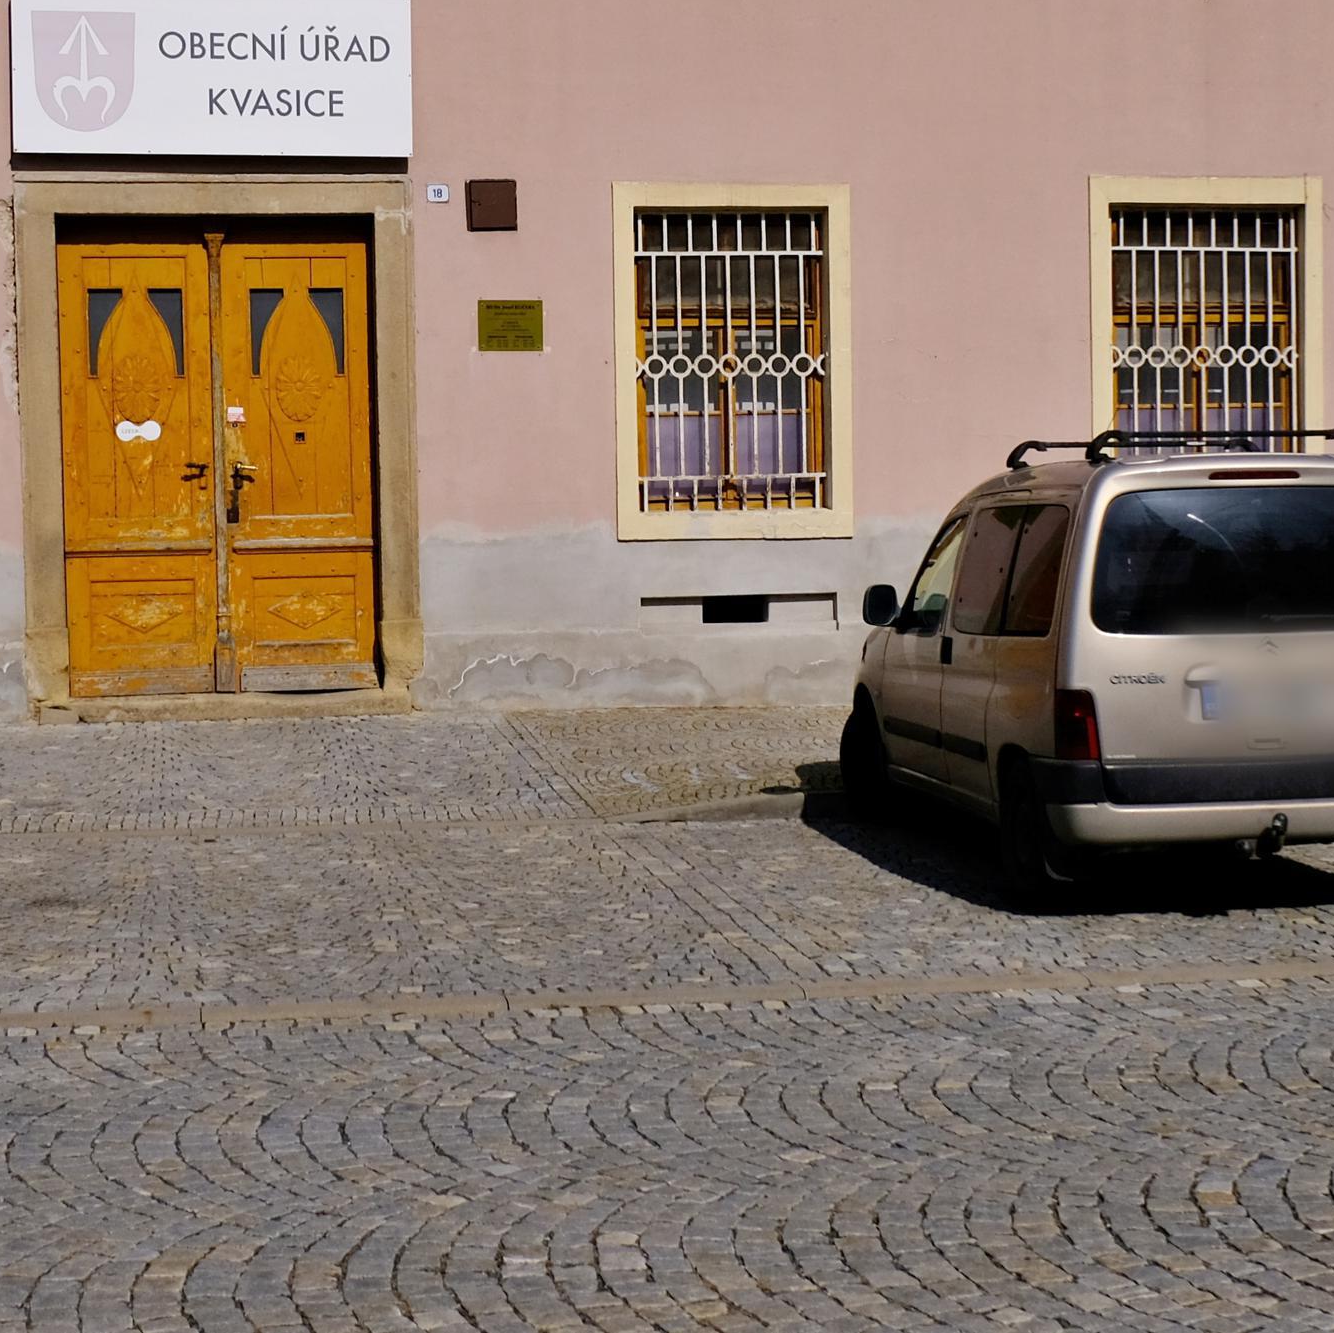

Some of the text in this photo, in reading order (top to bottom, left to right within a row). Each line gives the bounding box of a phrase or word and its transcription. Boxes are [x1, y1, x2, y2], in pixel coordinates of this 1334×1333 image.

[158, 25, 390, 62] OBECNÍ ÚŘAD
[208, 88, 344, 117] KVASICE
[433, 188, 443, 198] 18
[1109, 671, 1166, 685] CITROËN
